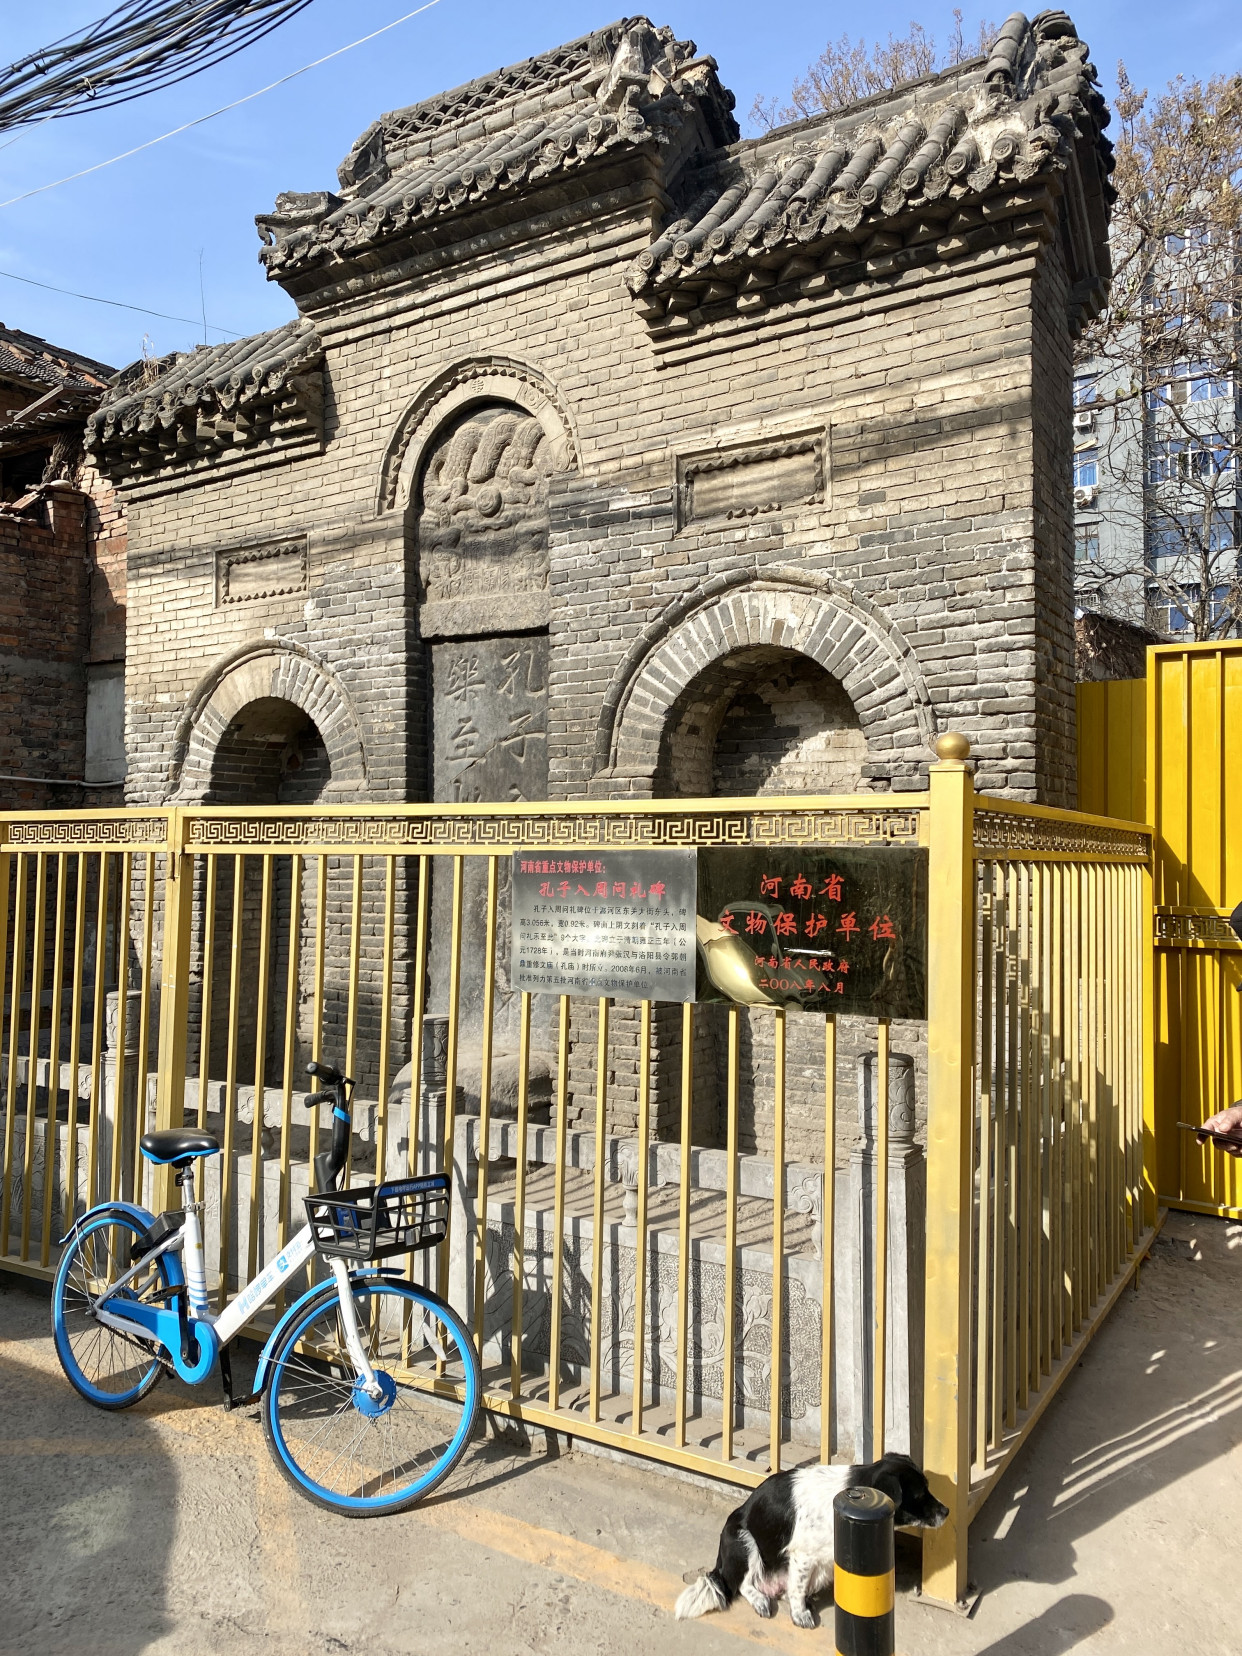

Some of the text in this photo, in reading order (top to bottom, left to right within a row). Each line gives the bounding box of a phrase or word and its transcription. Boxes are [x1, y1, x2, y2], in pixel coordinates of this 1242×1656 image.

[539, 881, 666, 900] 孔子入周问礼碑
[760, 873, 845, 901] 河南省
[718, 909, 896, 941] 文物保护单位
[754, 955, 850, 974] 河南省人民政府
